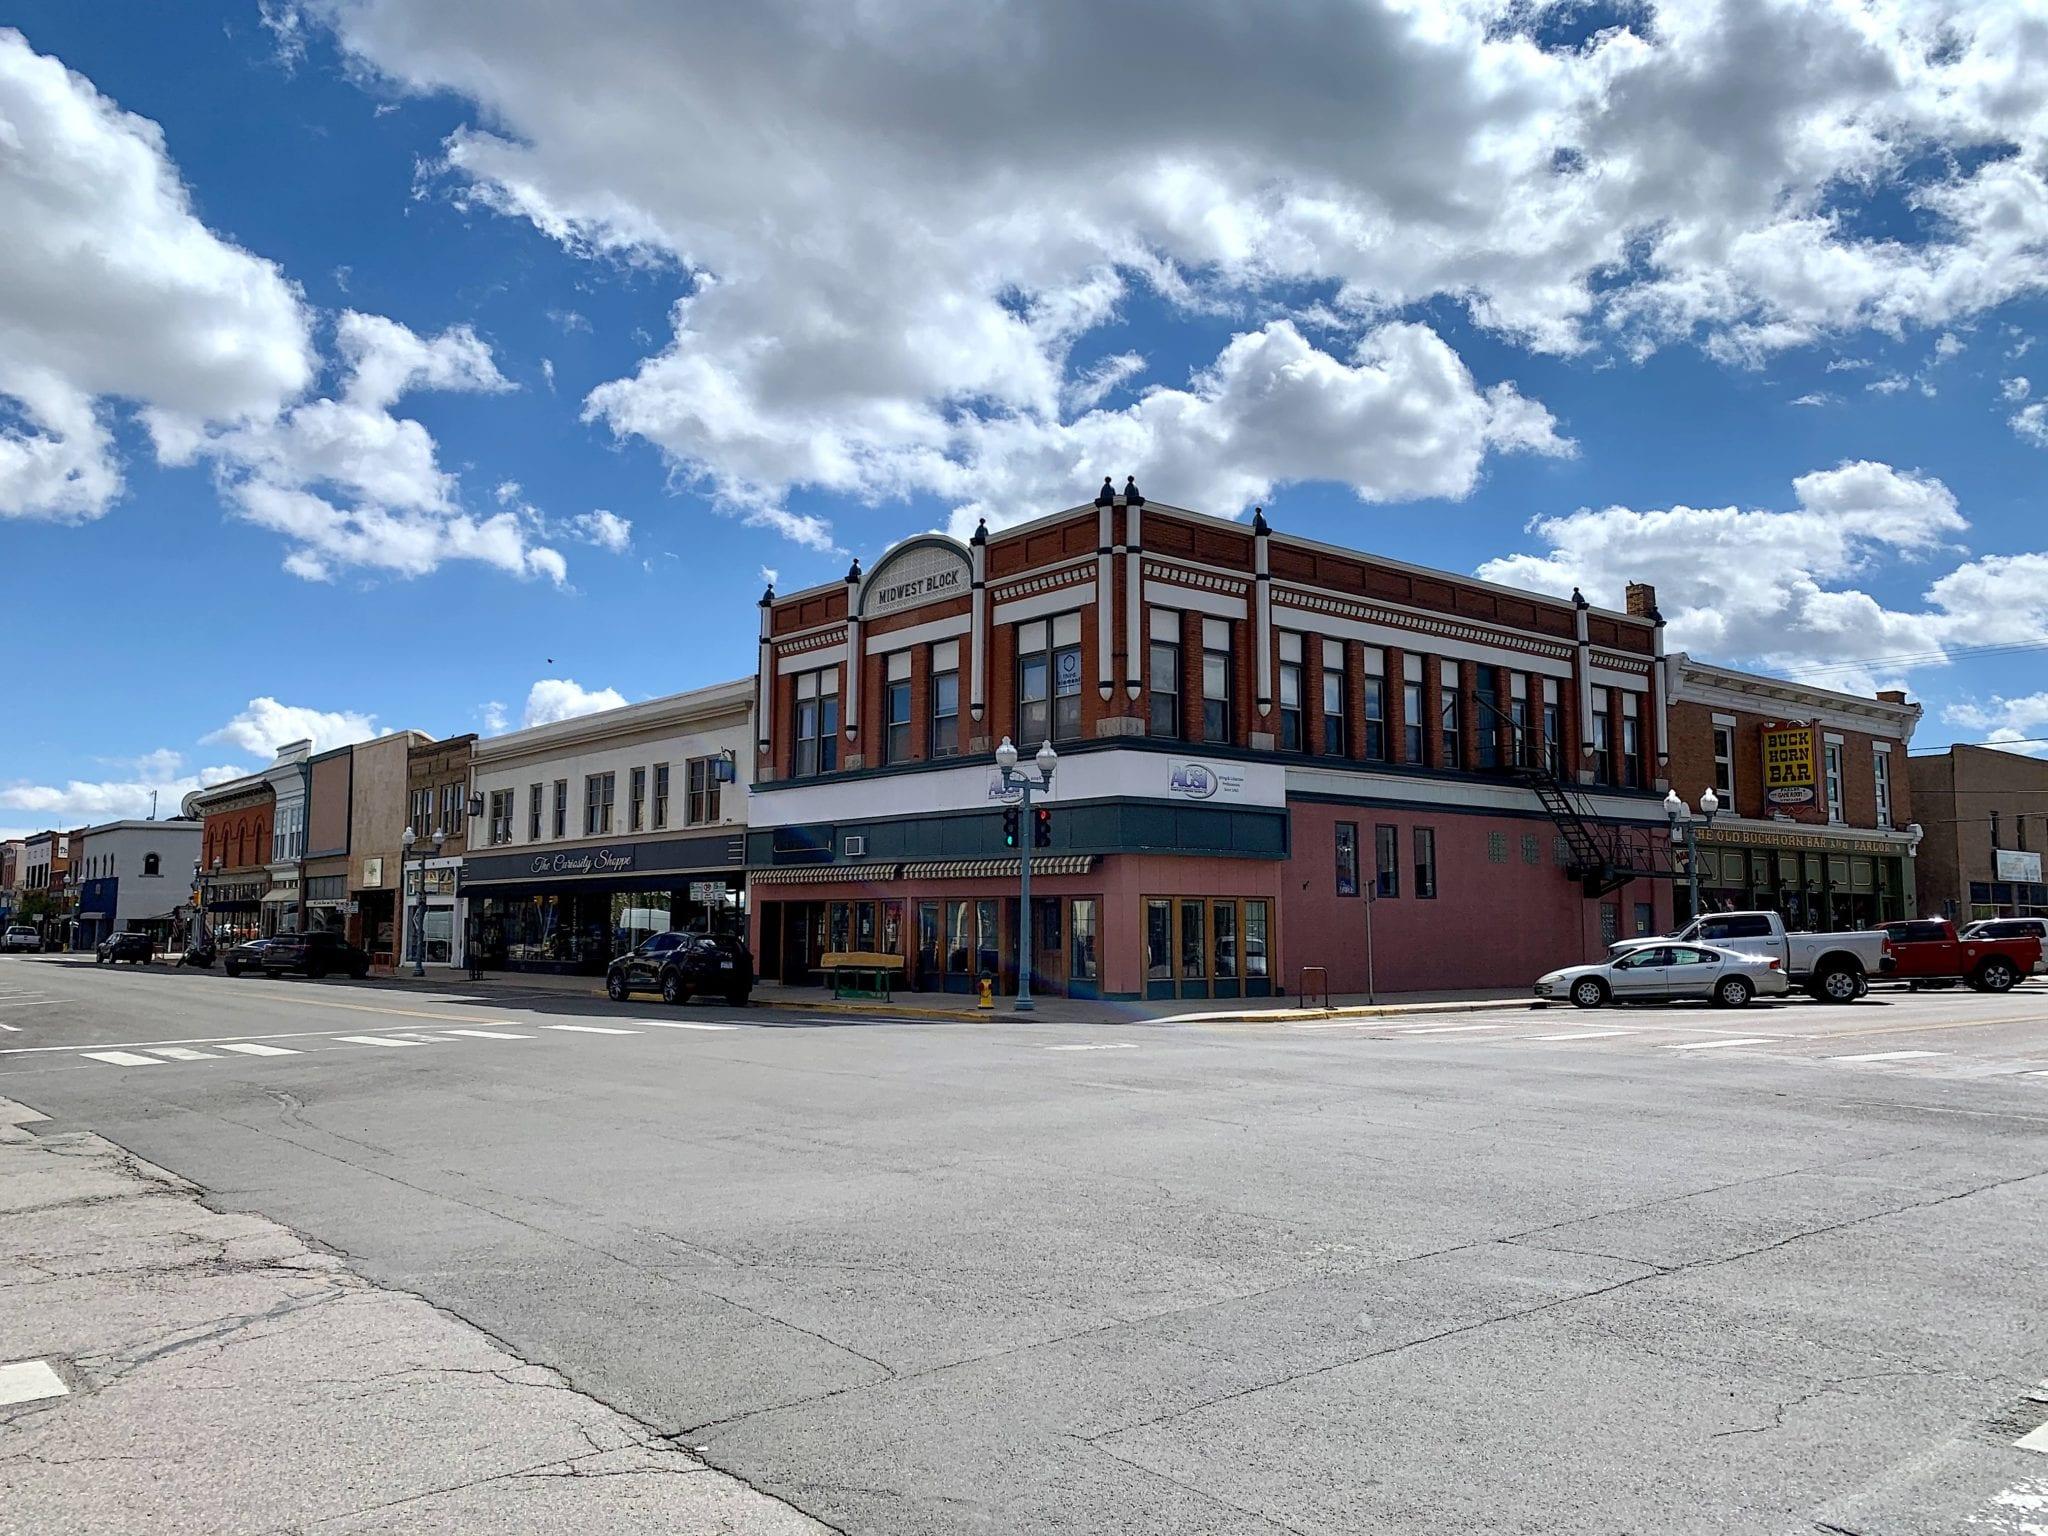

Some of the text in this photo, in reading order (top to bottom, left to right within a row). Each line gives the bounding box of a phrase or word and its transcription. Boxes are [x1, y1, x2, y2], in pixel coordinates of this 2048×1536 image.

[879, 570, 958, 604] MIDWEST BLOCK
[1768, 732, 1809, 747] BUCK
[1769, 748, 1809, 762] HORN
[1769, 764, 1811, 782] BAR
[1696, 829, 1714, 840] HE
[1716, 830, 1740, 843] OLD
[1743, 833, 1804, 848] BUCKHORN
[1807, 837, 1826, 848] BAR
[1854, 841, 1890, 852] PARLOR
[531, 849, 632, 874] The Curiosity Shoppe
